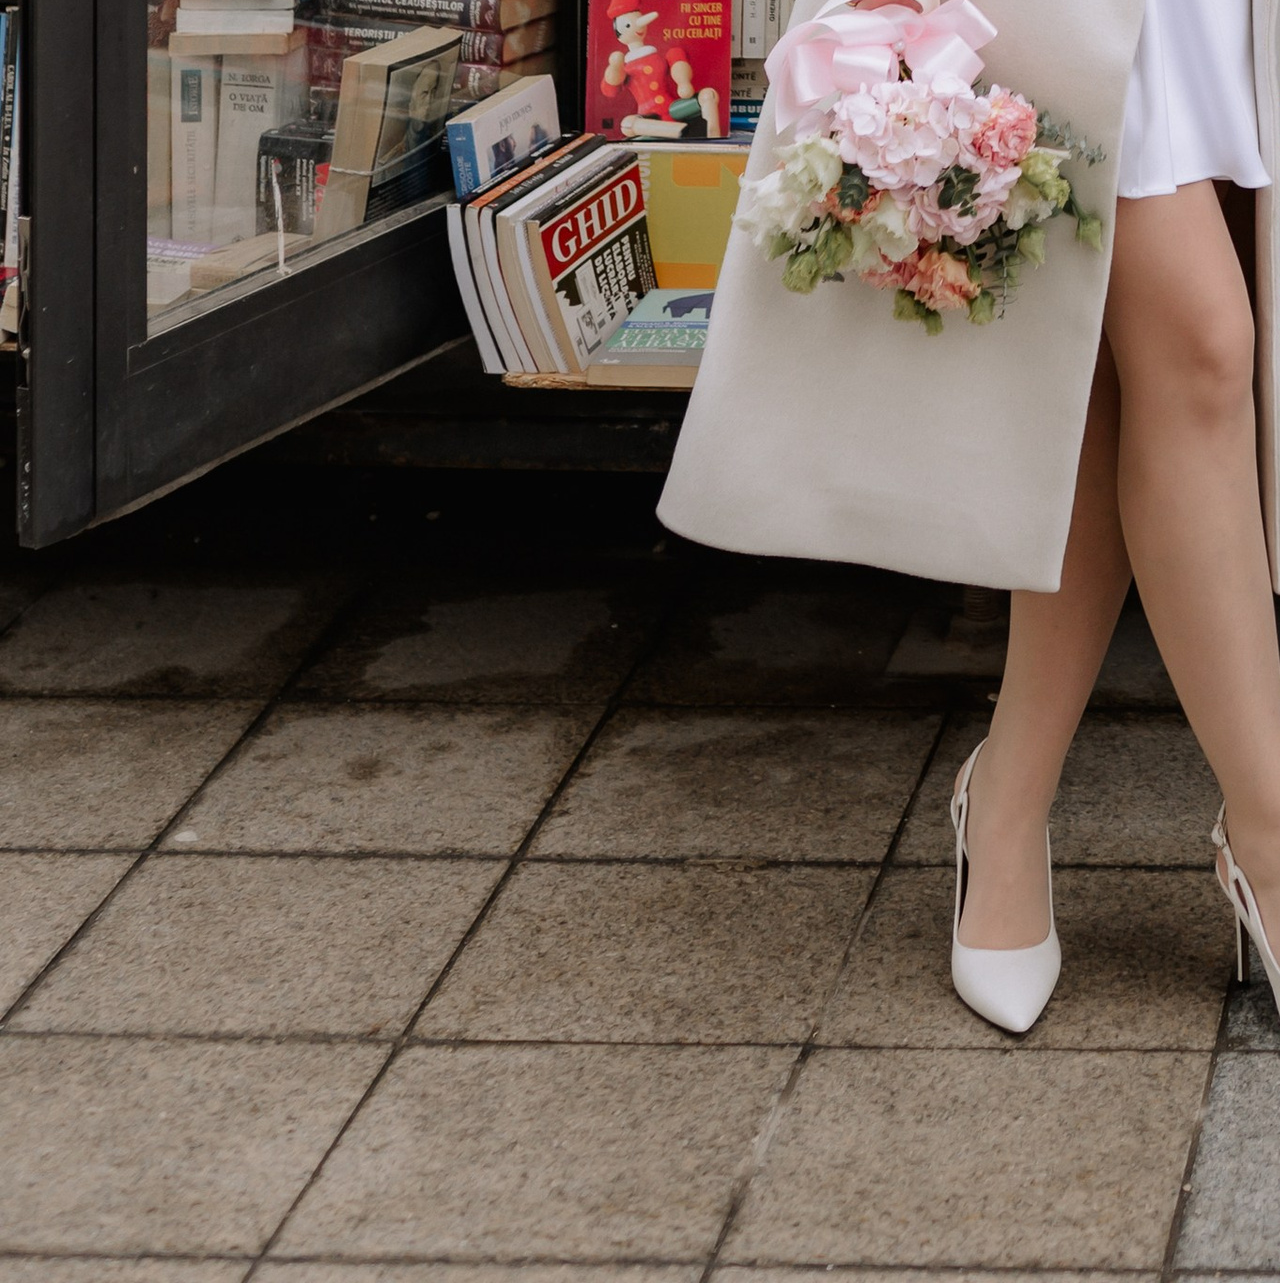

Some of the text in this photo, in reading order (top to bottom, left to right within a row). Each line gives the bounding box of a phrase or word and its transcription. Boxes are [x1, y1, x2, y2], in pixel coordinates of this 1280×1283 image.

[680, 2, 723, 14] FII SINCER
[689, 16, 722, 26] CU TINE
[673, 28, 685, 40] CU
[232, 102, 265, 114] DE OM
[552, 179, 638, 263] GHID
[620, 234, 637, 281] PENTRU
[611, 241, 635, 316] ELABORAREA
